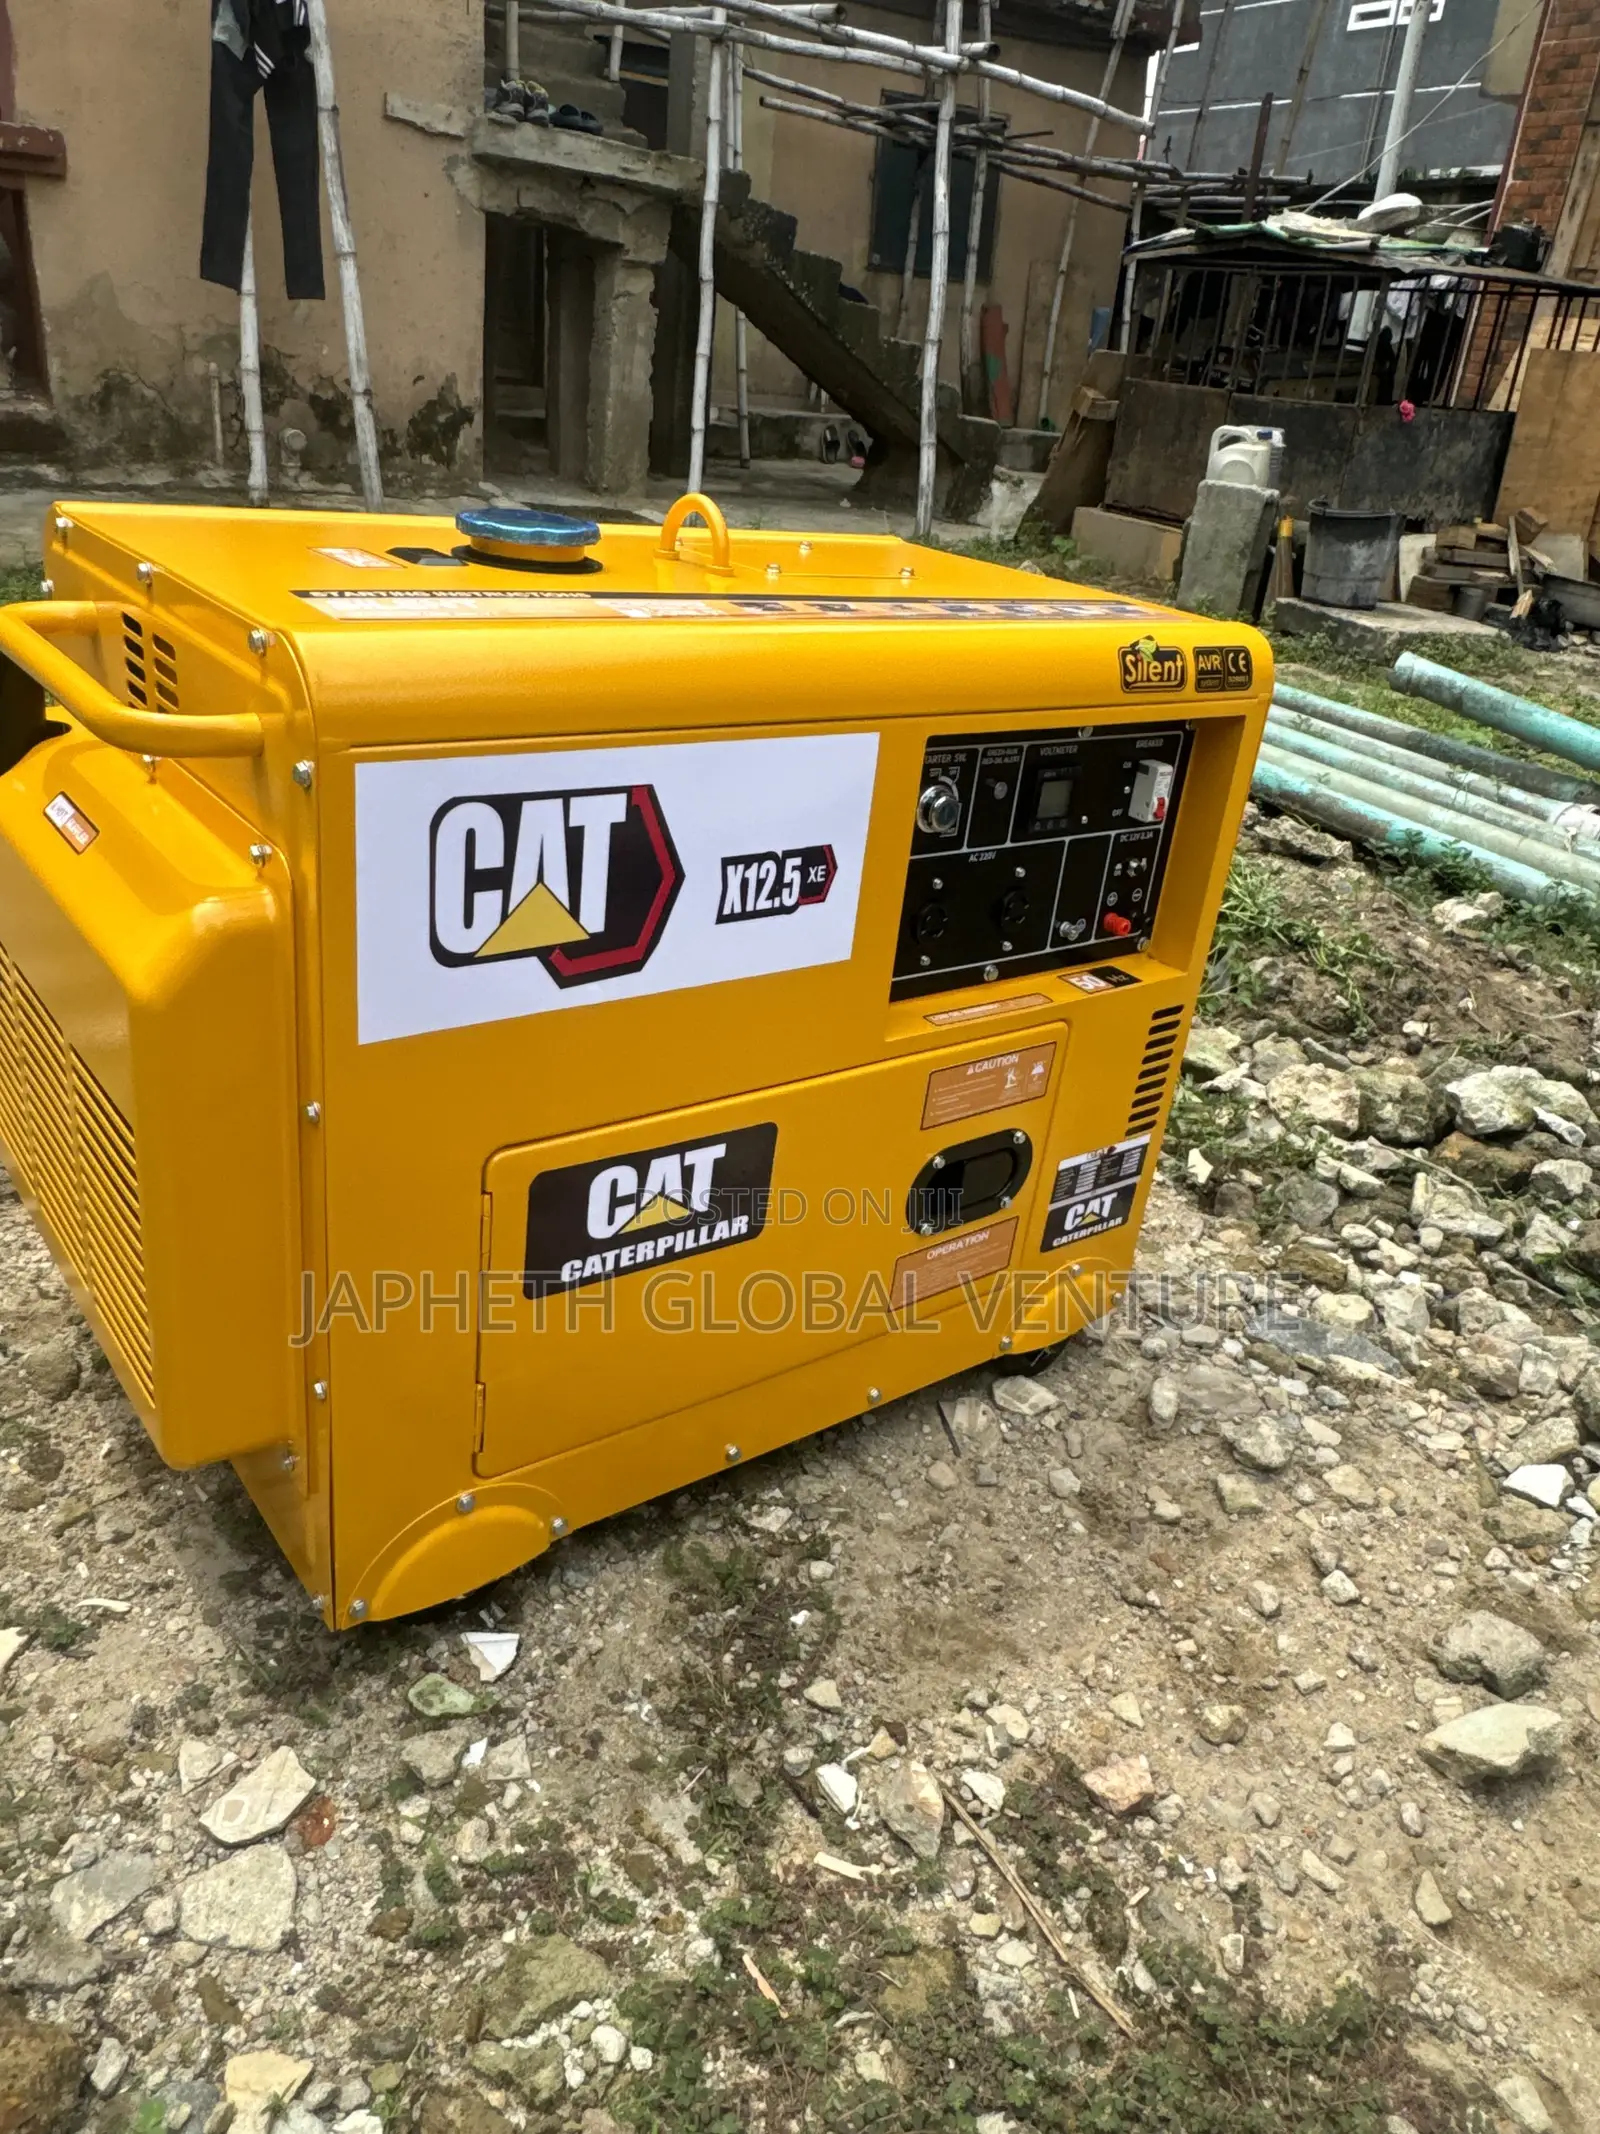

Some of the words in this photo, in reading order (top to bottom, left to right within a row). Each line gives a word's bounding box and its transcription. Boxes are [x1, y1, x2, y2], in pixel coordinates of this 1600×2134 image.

[1125, 653, 1183, 683] Silent
[1198, 654, 1222, 671] AVR
[1228, 652, 1248, 673] CE
[1040, 744, 1079, 757] VOLTMETER
[436, 793, 628, 955] CAT
[722, 857, 802, 915] X12.5
[807, 864, 827, 884] XE
[1071, 974, 1107, 990] 50
[974, 1053, 1020, 1073] CAUTION
[586, 1143, 727, 1240] CAT
[1064, 1191, 1119, 1231] CAT
[926, 1229, 991, 1261] OPERATION
[1052, 1216, 1124, 1247] CATERPILLAR
[560, 1214, 749, 1282] CATERPILLAR
